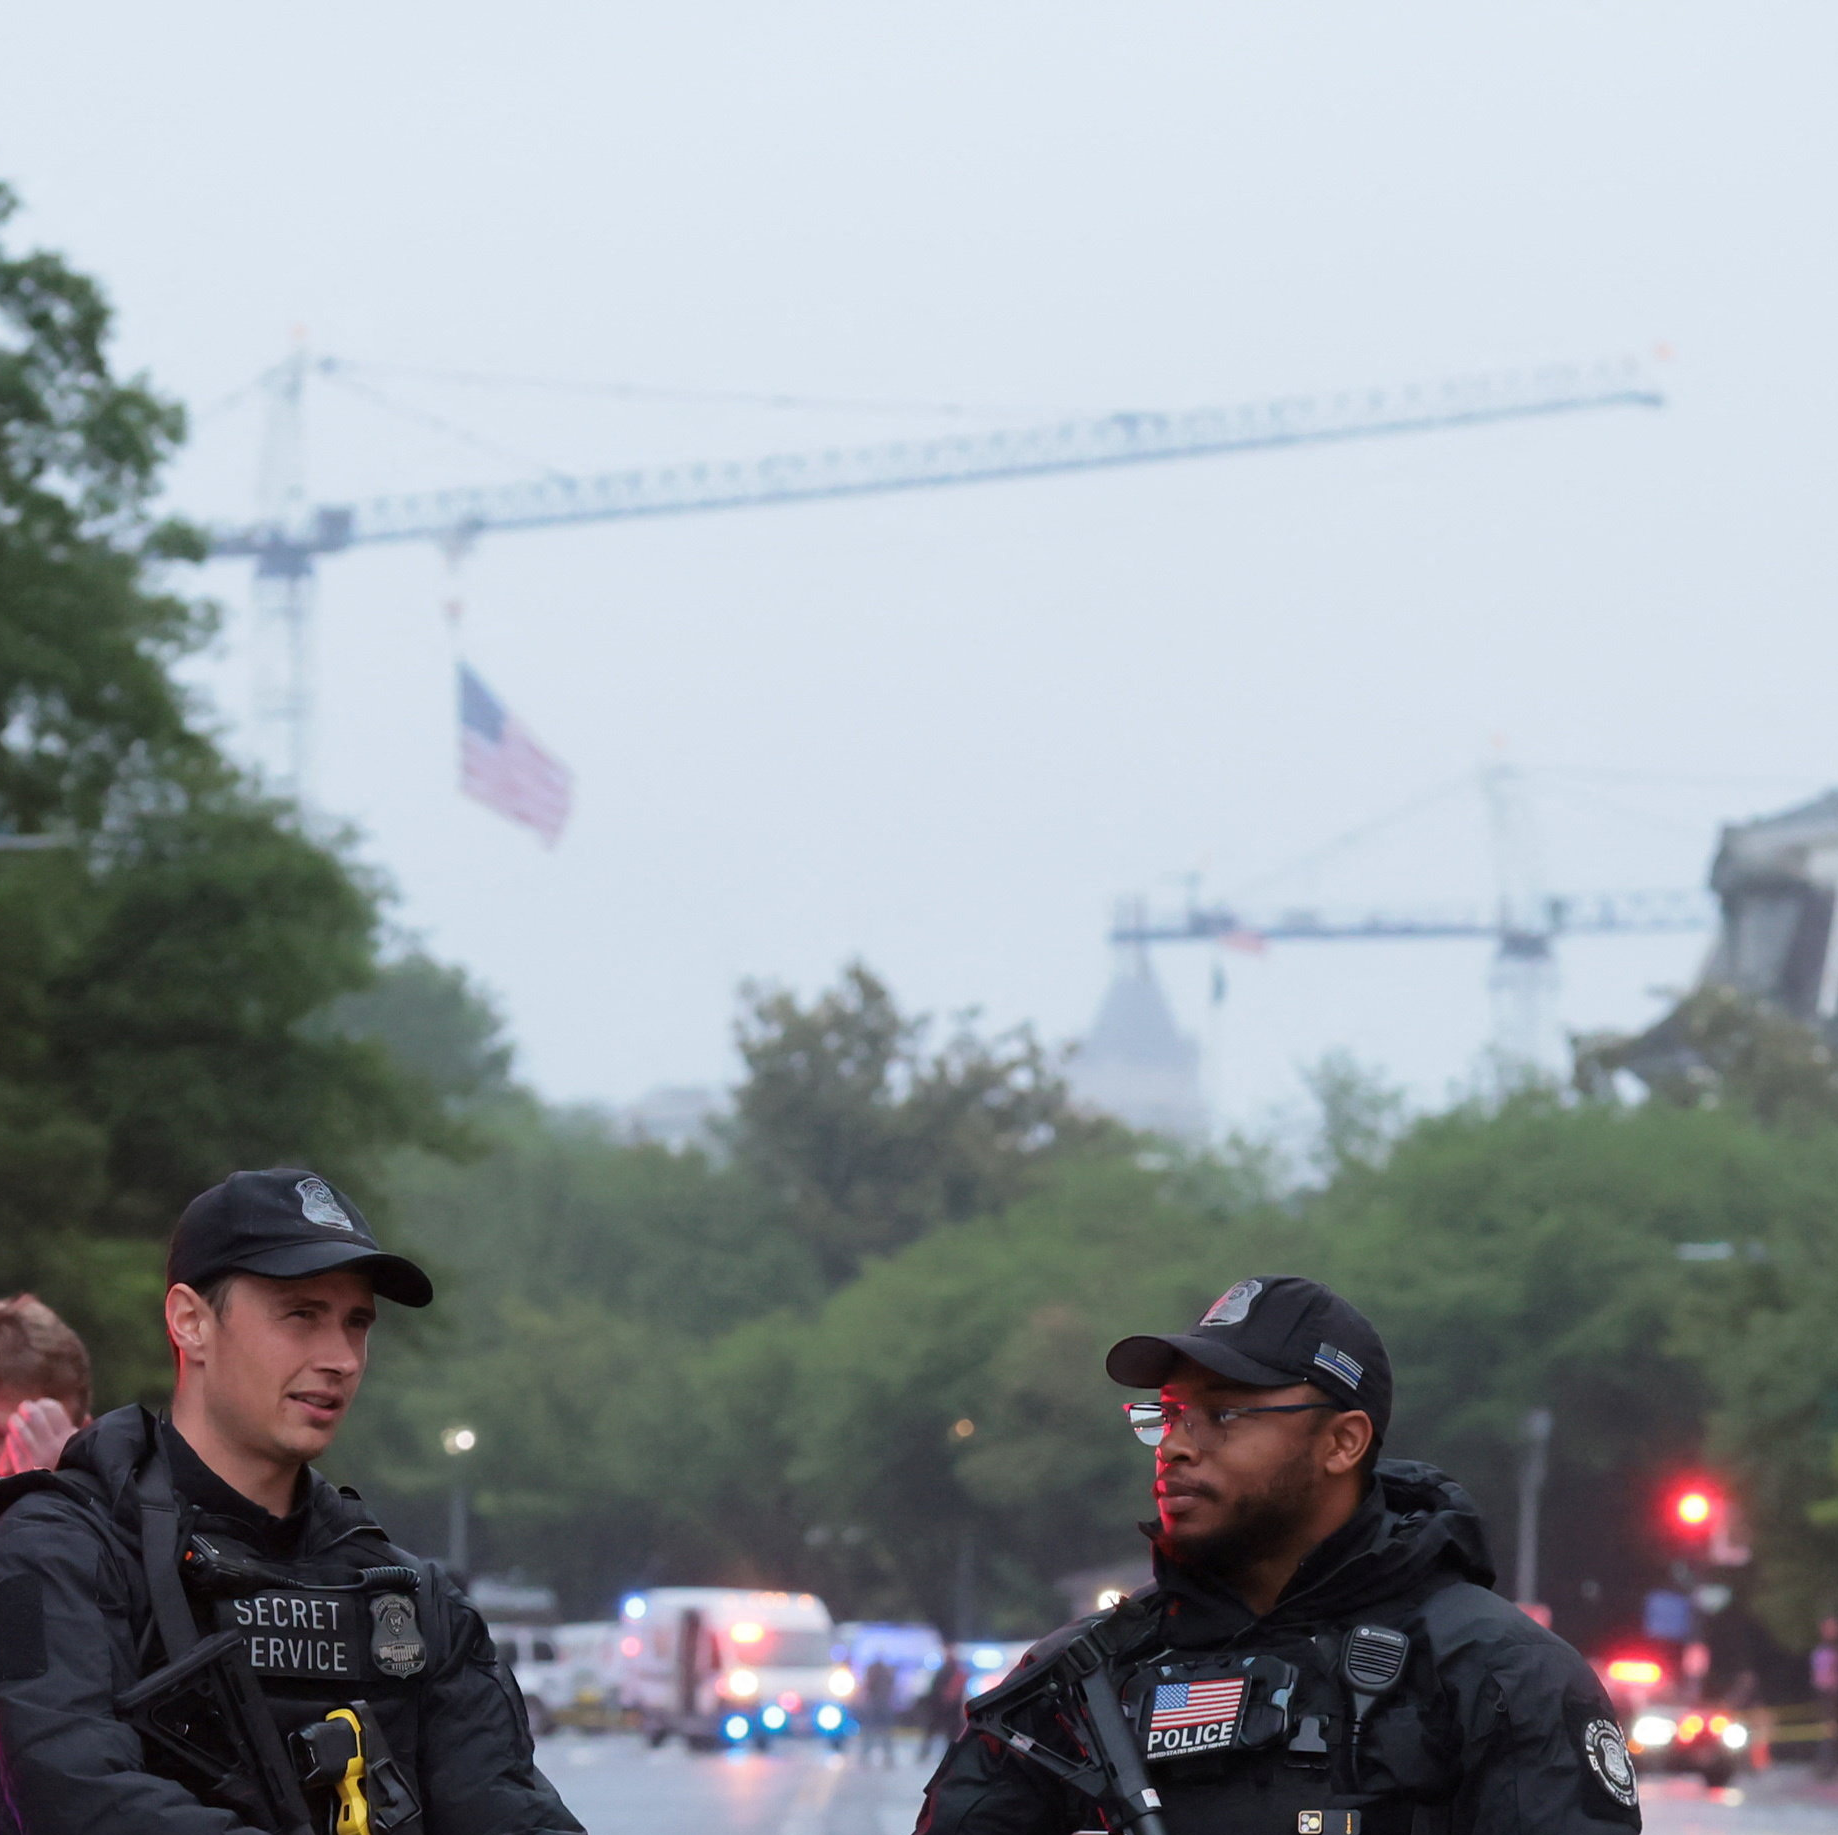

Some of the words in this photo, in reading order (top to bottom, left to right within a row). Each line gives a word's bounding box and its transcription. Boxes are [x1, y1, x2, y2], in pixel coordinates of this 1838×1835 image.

[233, 1597, 340, 1631] SECRET
[243, 1636, 348, 1672] ERVICE
[1147, 1720, 1235, 1752] POLICE
